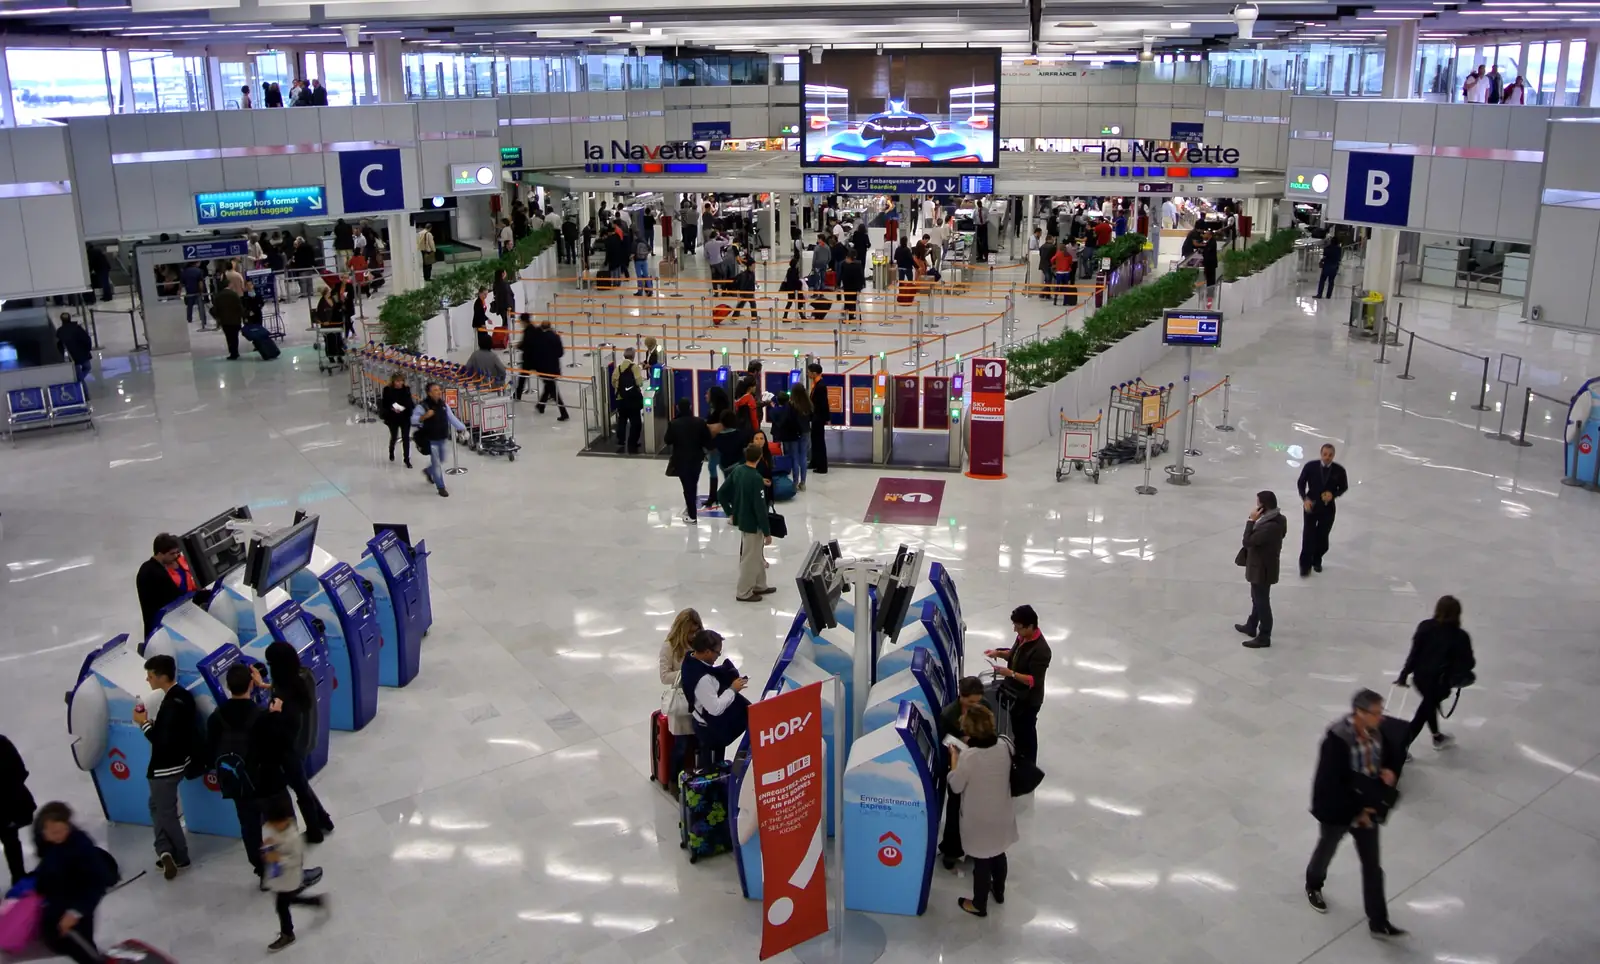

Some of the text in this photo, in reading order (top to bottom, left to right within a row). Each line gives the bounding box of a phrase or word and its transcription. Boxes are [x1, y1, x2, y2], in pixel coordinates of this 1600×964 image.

[584, 140, 707, 160] la Navette
[1101, 141, 1240, 164] la Navette
[359, 163, 386, 197] C
[869, 178, 937, 193] Embarquement 20
[1364, 169, 1390, 207] B
[219, 197, 299, 210] Bagages hors format
[221, 206, 294, 217] Oversized baggage
[186, 246, 196, 259] 2
[1201, 323, 1207, 331] 4
[760, 711, 812, 747] HOP!
[758, 771, 816, 801] ENREGISTREZ-VOUS
[762, 780, 812, 806] SUR LES BORNES
[770, 790, 806, 810] AIR FRANCE
[860, 794, 920, 808] Enregistrement
[860, 801, 892, 812] Express
